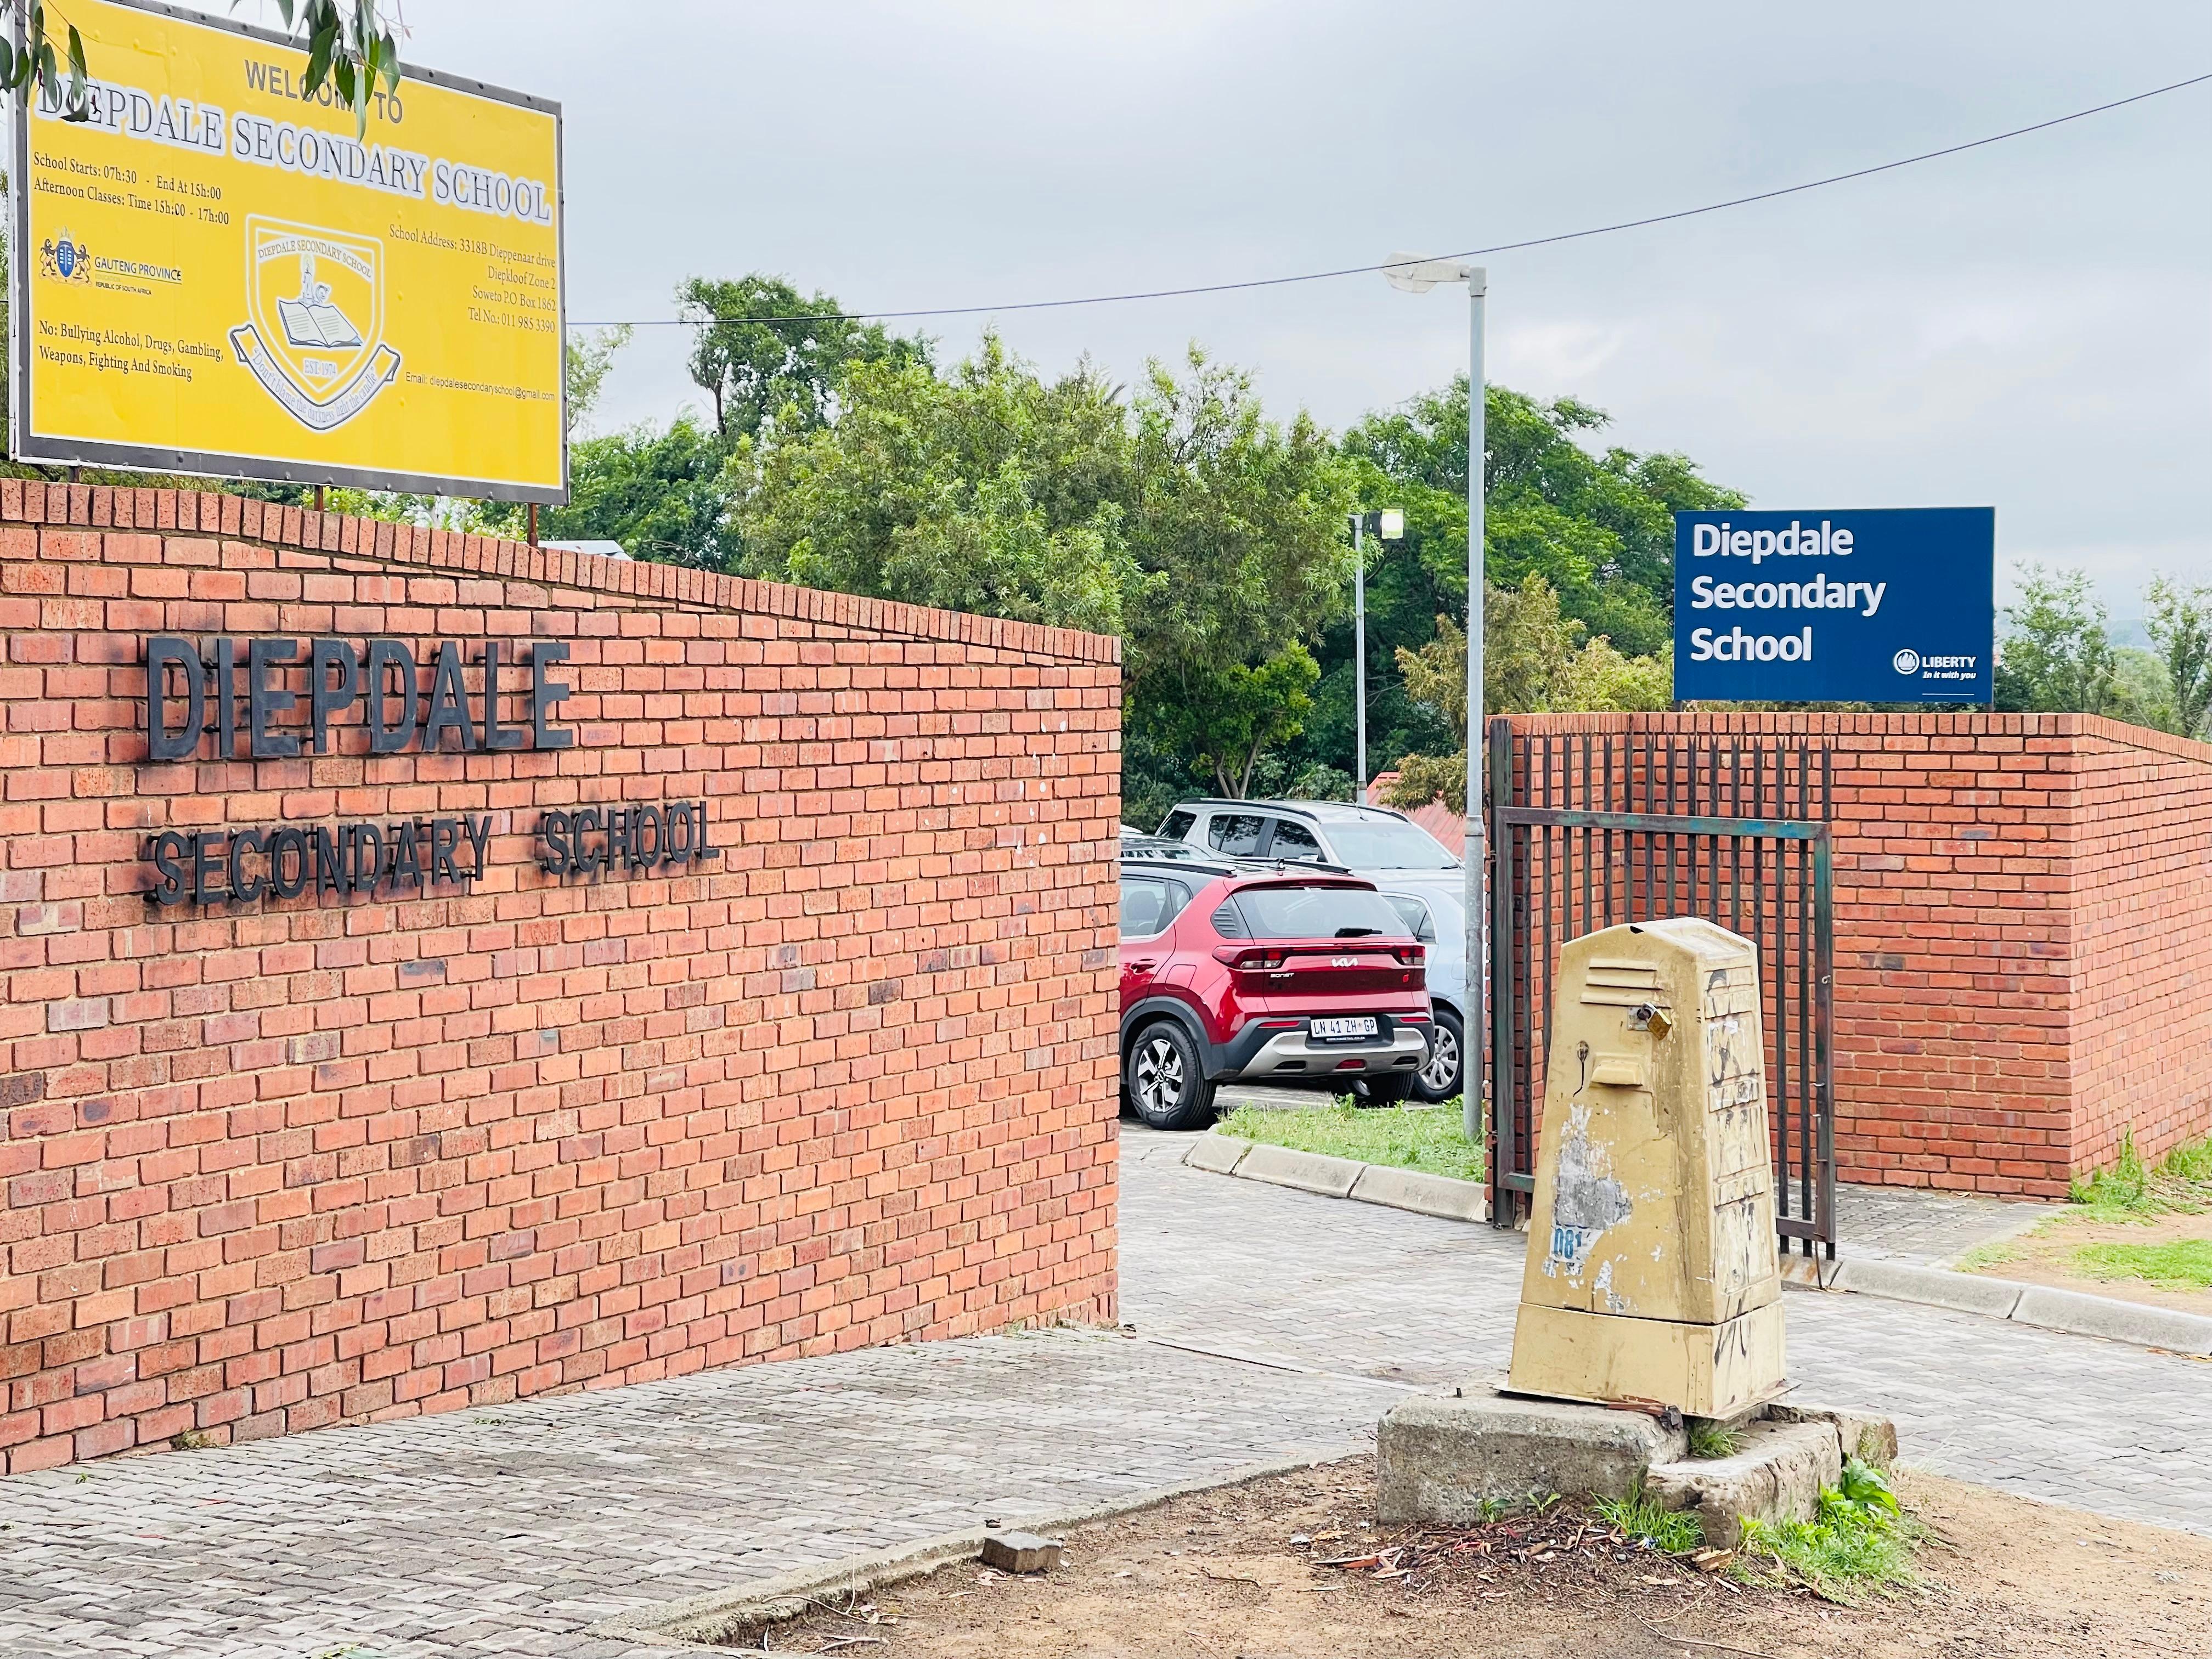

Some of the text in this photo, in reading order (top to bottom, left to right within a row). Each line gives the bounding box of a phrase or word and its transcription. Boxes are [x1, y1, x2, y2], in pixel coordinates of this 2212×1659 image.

[374, 91, 402, 123] TO
[33, 151, 67, 171] School
[70, 159, 101, 177] Starts:
[104, 166, 137, 184] 07h:30
[156, 176, 176, 192] End
[177, 177, 188, 194] At
[190, 183, 221, 200] 15h:00
[236, 119, 426, 193] SECONDARY
[436, 165, 549, 221] SCHOOL
[35, 177, 84, 199] Afternoon
[87, 187, 125, 205] Classes:
[127, 195, 151, 211] Time
[155, 200, 185, 217] 15h:00
[198, 208, 229, 225] 17h:00
[258, 240, 371, 278] DIEPDALE SECONDARY SCHOOL
[390, 223, 555, 268] School Address: 3318B Dieppenaar drive
[94, 257, 182, 281] GAUTENG PROVINCE
[95, 281, 115, 290] REPUBLIC
[488, 266, 556, 290] Diepkloof Zone 2
[473, 285, 501, 302] Soweto
[520, 294, 535, 308] Box
[538, 297, 556, 312] 1862
[468, 307, 481, 321] Tel
[501, 313, 515, 327] 011
[518, 315, 533, 330] 985
[536, 319, 555, 334] 3390
[39, 320, 223, 362] No: Bullying Alcohol, Drugs, Gambling,
[40, 345, 192, 382] Weapons, Fighting And Smoking
[322, 363, 336, 378] 1974
[405, 372, 427, 385] Email:
[1694, 520, 1854, 565] Diepdale
[1691, 573, 1887, 617] Secondary
[1691, 626, 1812, 661] School
[1922, 656, 1977, 668] LIBERTY
[1960, 673, 1977, 681] you
[146, 636, 574, 760] DIEPDALE
[154, 800, 721, 906] SECONDARY SCHOOL
[1313, 1019, 1375, 1034] LN 41 ZH GP
